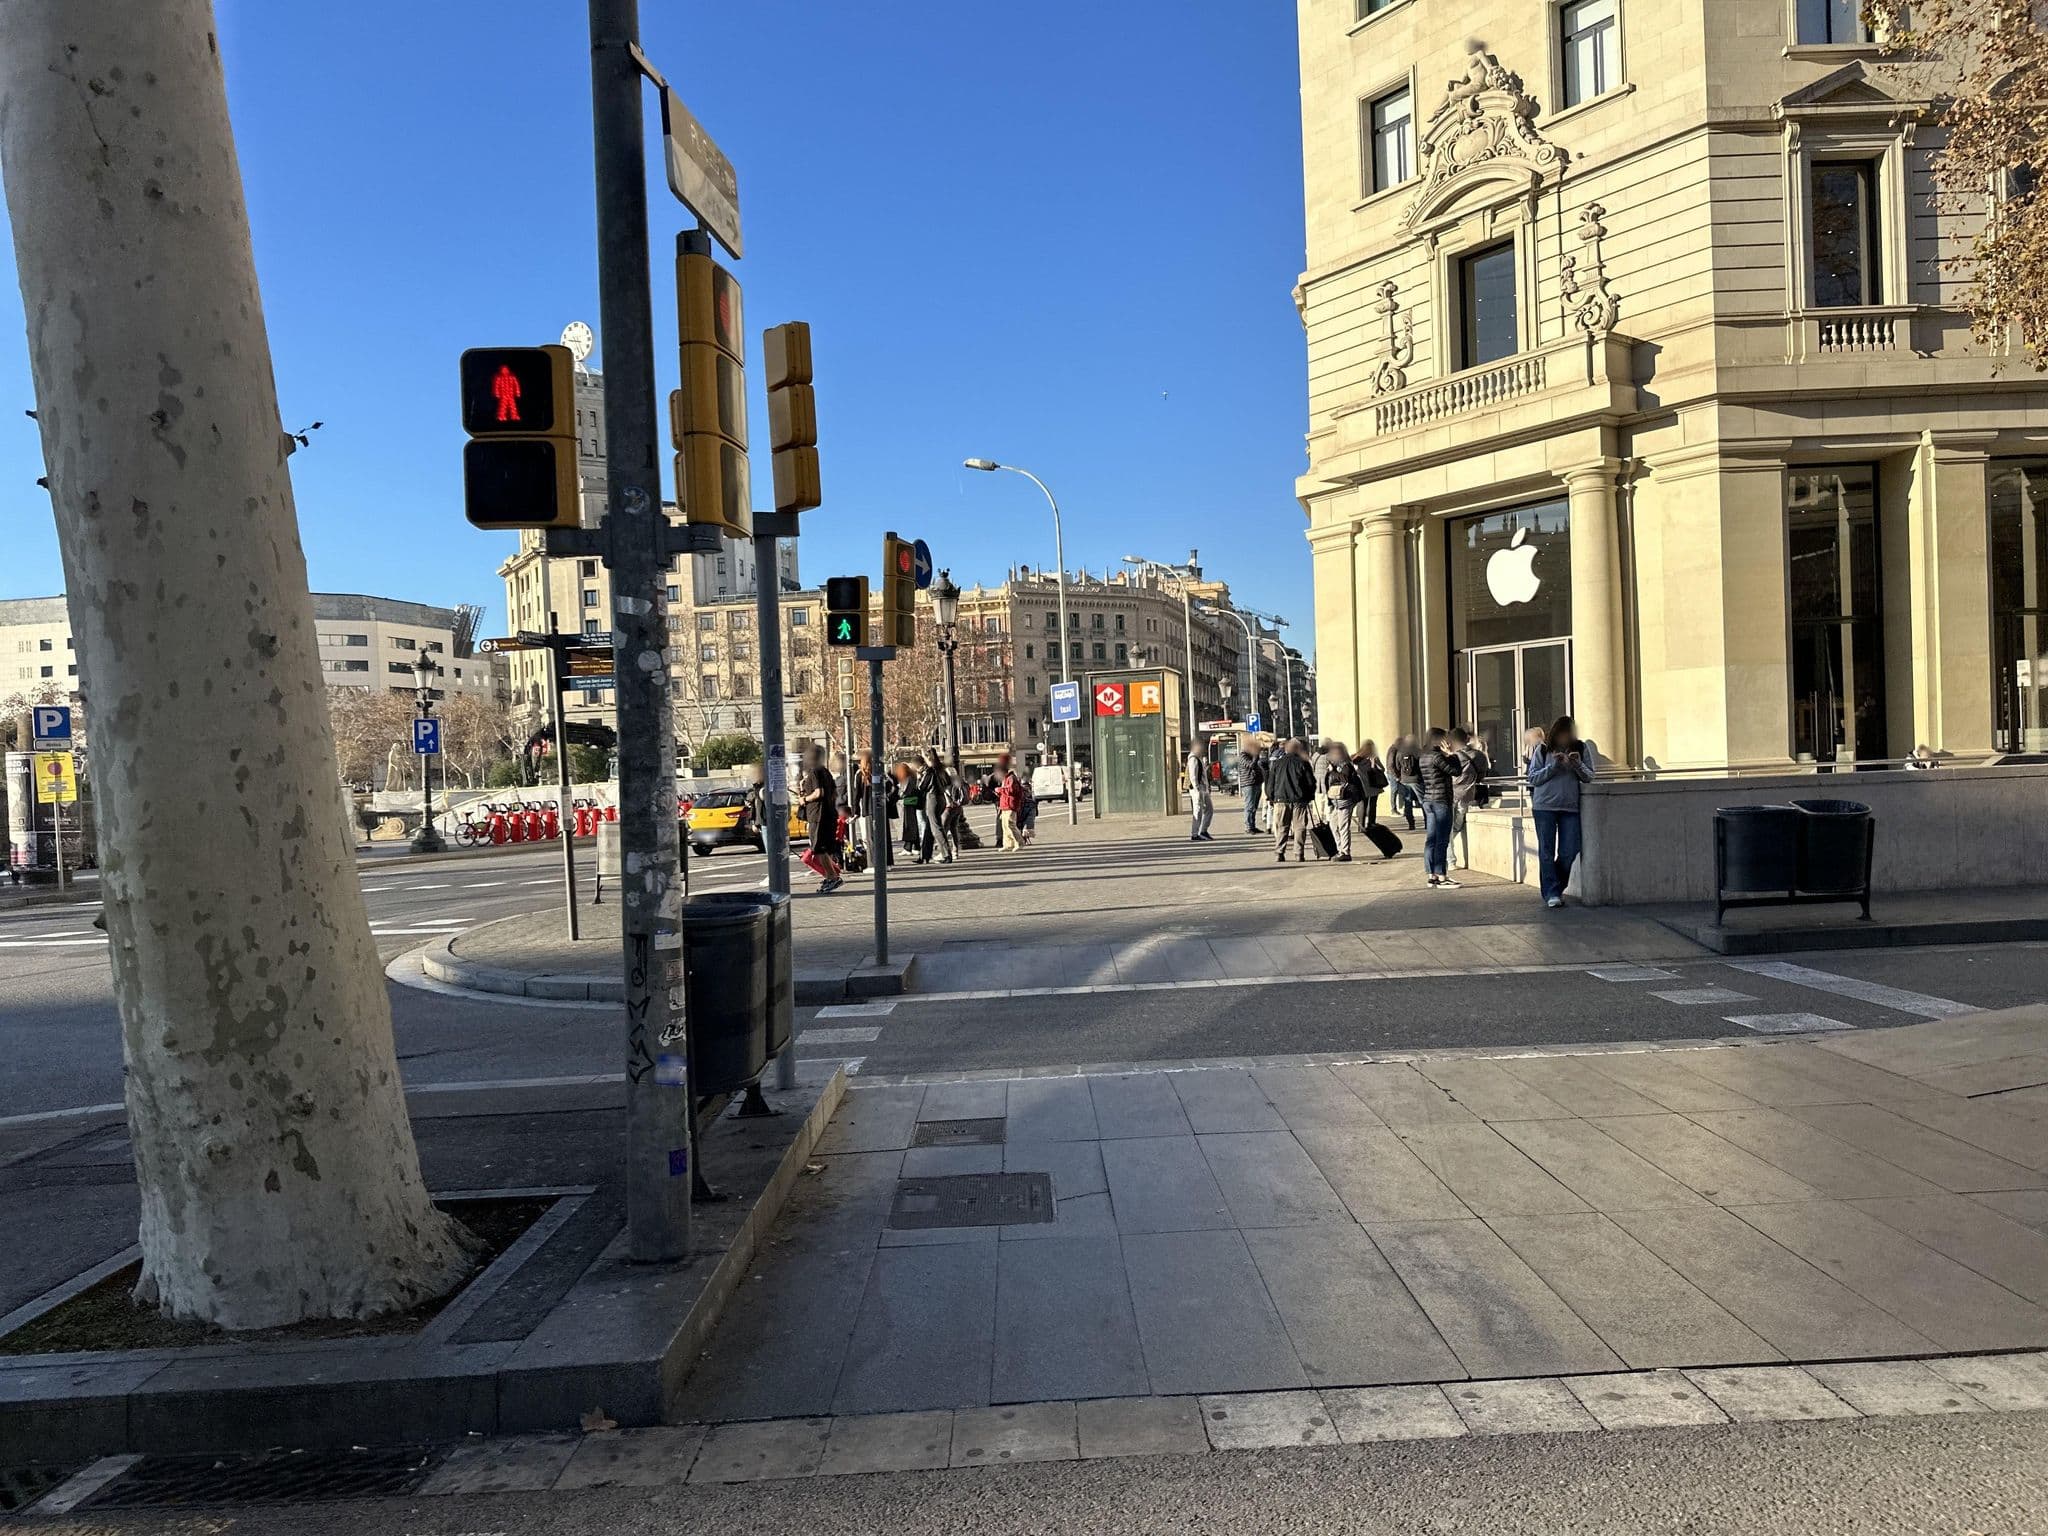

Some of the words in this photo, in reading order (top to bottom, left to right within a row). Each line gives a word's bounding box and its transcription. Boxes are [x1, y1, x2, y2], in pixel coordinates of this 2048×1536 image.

[1103, 692, 1114, 702] M
[39, 709, 63, 736] P
[1249, 715, 1257, 726] P
[417, 721, 434, 740] P
